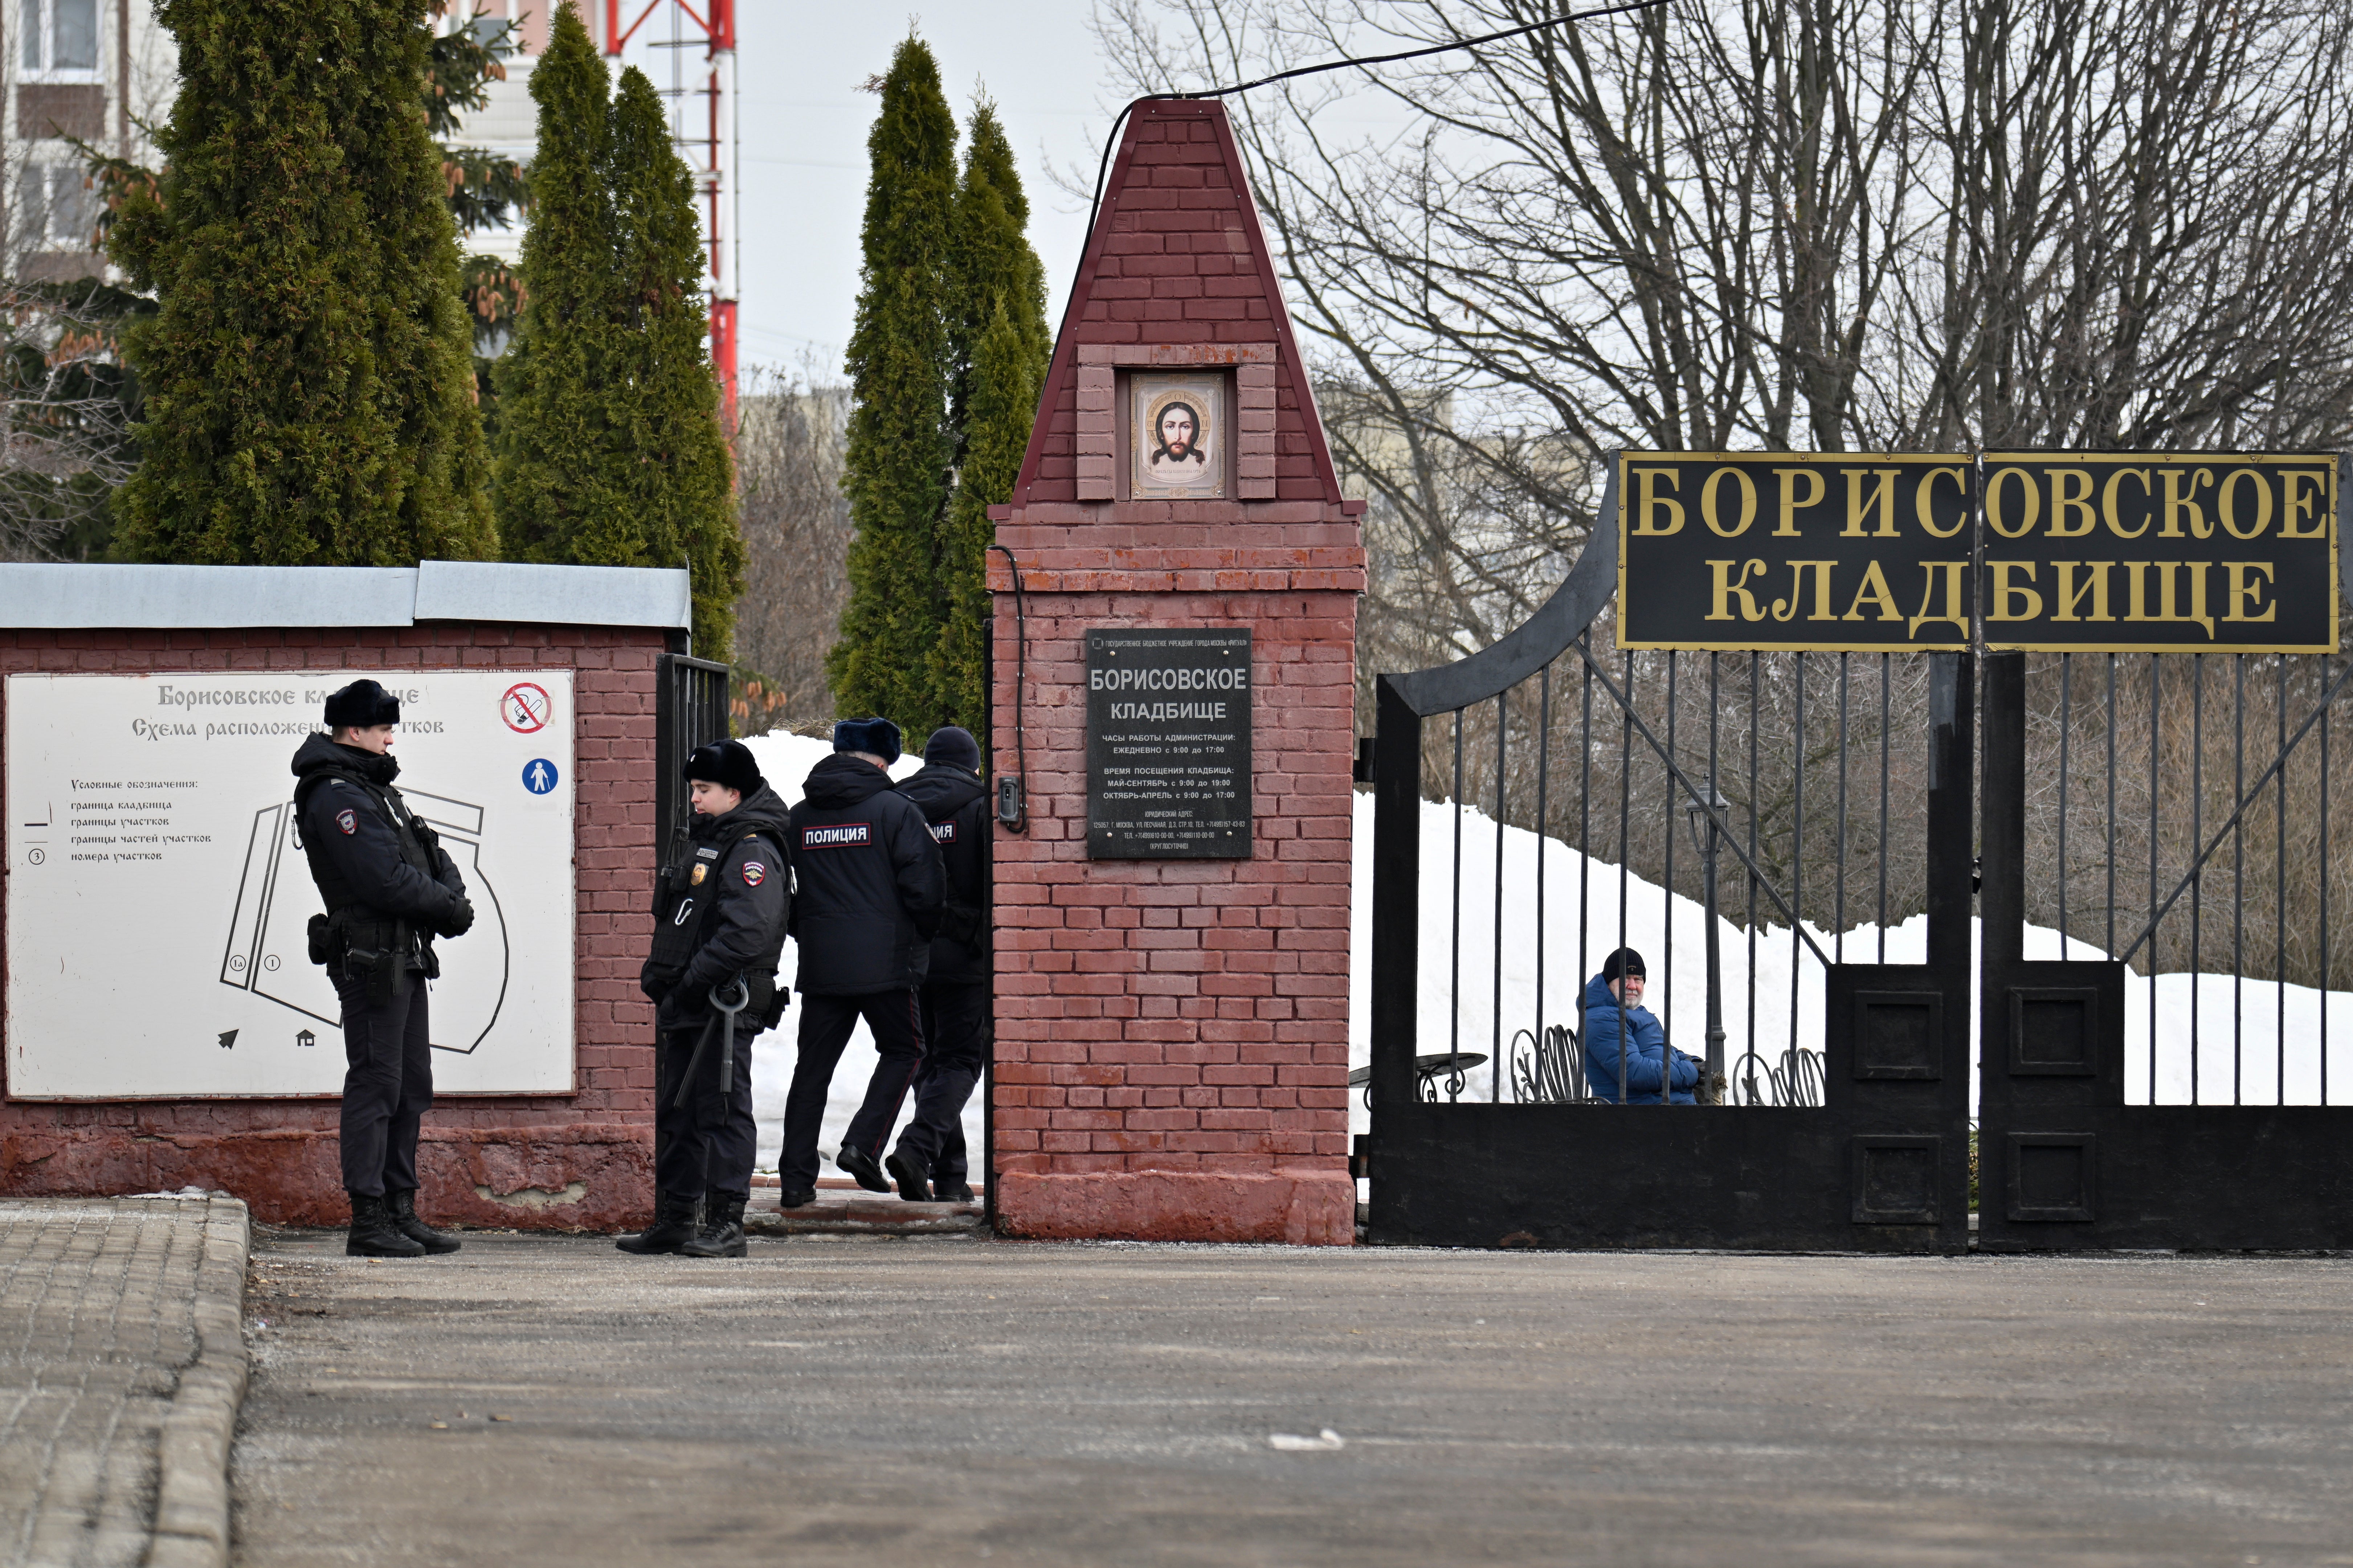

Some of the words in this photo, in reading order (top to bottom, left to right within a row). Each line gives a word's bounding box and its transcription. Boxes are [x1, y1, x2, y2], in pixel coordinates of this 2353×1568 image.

[1632, 467, 2327, 539] БОРИСОВСКОЕ
[1704, 558, 2276, 640] КЛАДБИЩЕ
[1091, 668, 1246, 690] БОРИСОВСКОЕ
[158, 685, 295, 711] Борисовское
[1111, 703, 1226, 722] КЛАДБИЩЕ
[132, 719, 196, 741] Схема
[206, 722, 331, 741] расположени
[71, 779, 123, 791] Условные
[127, 780, 198, 789] обозначения:
[71, 802, 114, 812] граница
[118, 802, 172, 811] кладбища
[71, 819, 116, 828] границы
[121, 818, 169, 828] участков
[71, 835, 116, 846] границы
[121, 834, 158, 843] частей
[163, 835, 211, 845] участков
[806, 828, 866, 844] ПОЛИЦИЯ
[34, 852, 40, 861] 3
[71, 853, 109, 863] номера
[114, 852, 162, 863] участков
